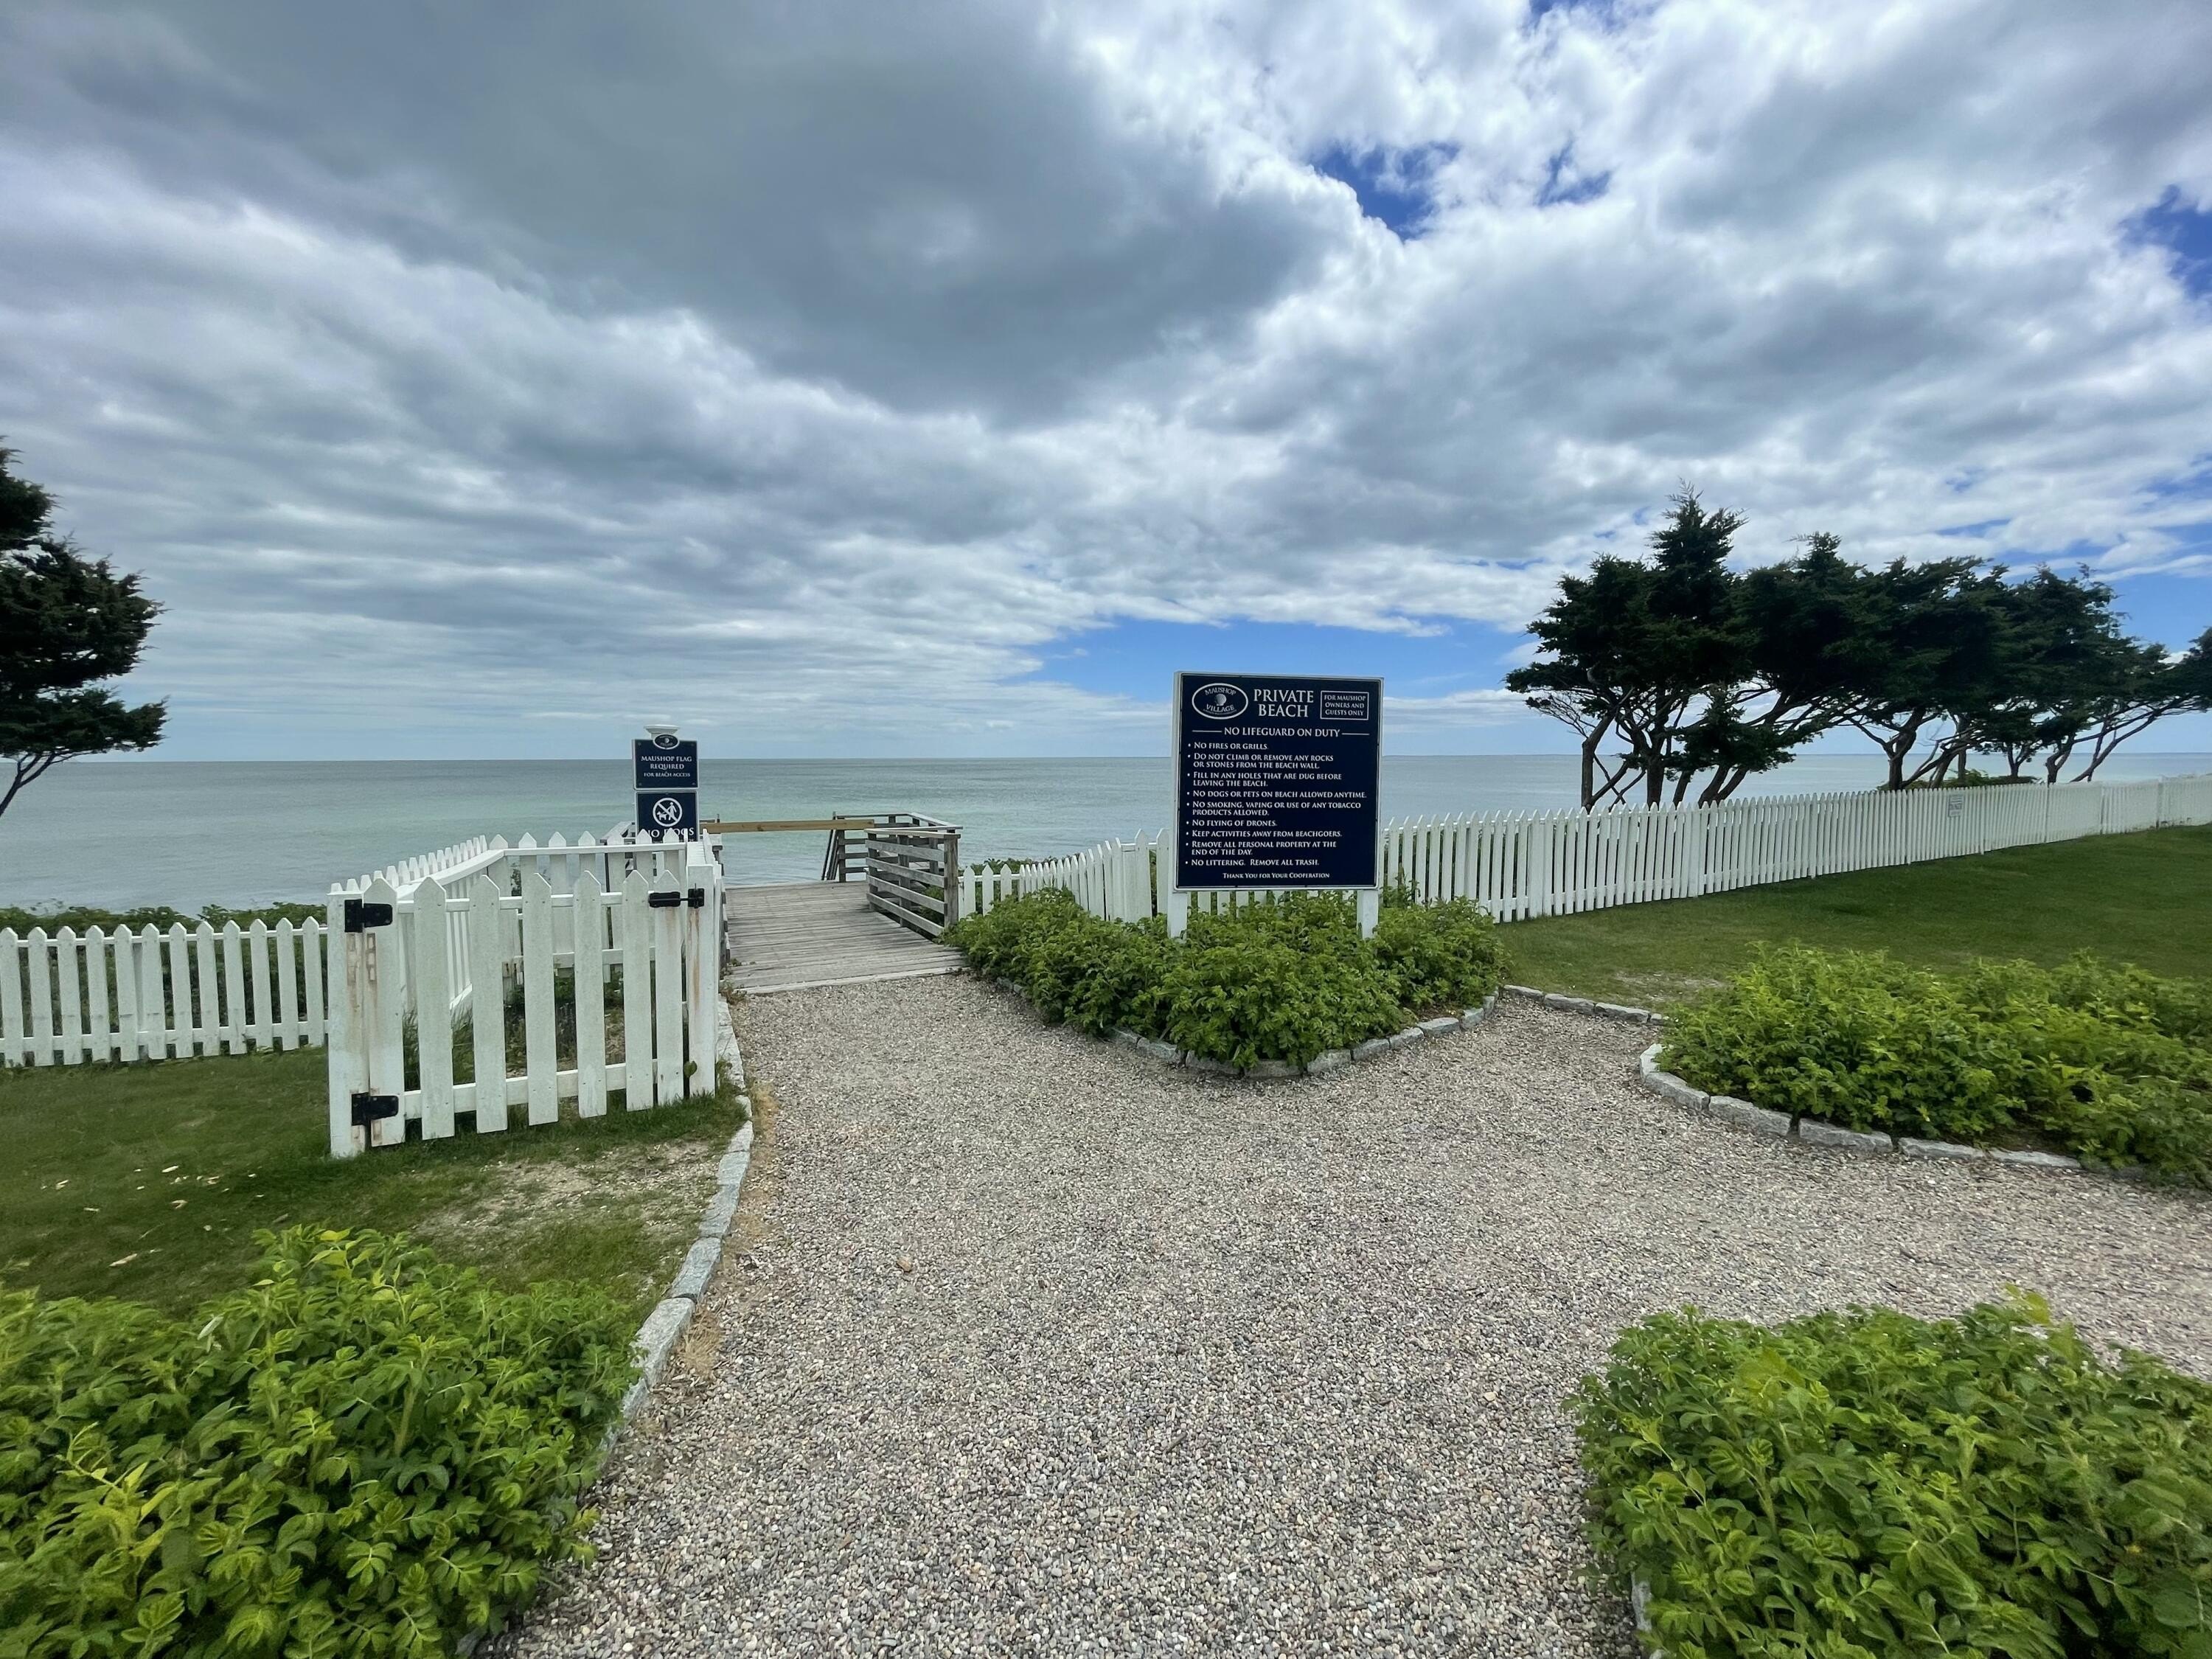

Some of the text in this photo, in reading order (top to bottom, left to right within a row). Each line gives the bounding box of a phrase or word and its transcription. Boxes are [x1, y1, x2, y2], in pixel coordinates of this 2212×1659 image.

[1205, 687, 1237, 695] MAUSHOP
[1253, 689, 1314, 703] PRIVATE
[1206, 704, 1234, 712] VILLAGE
[1258, 704, 1308, 717] BEACH
[1242, 728, 1294, 737] LIFEGUARD
[1295, 728, 1312, 737] ON
[1315, 728, 1340, 737] DUTY
